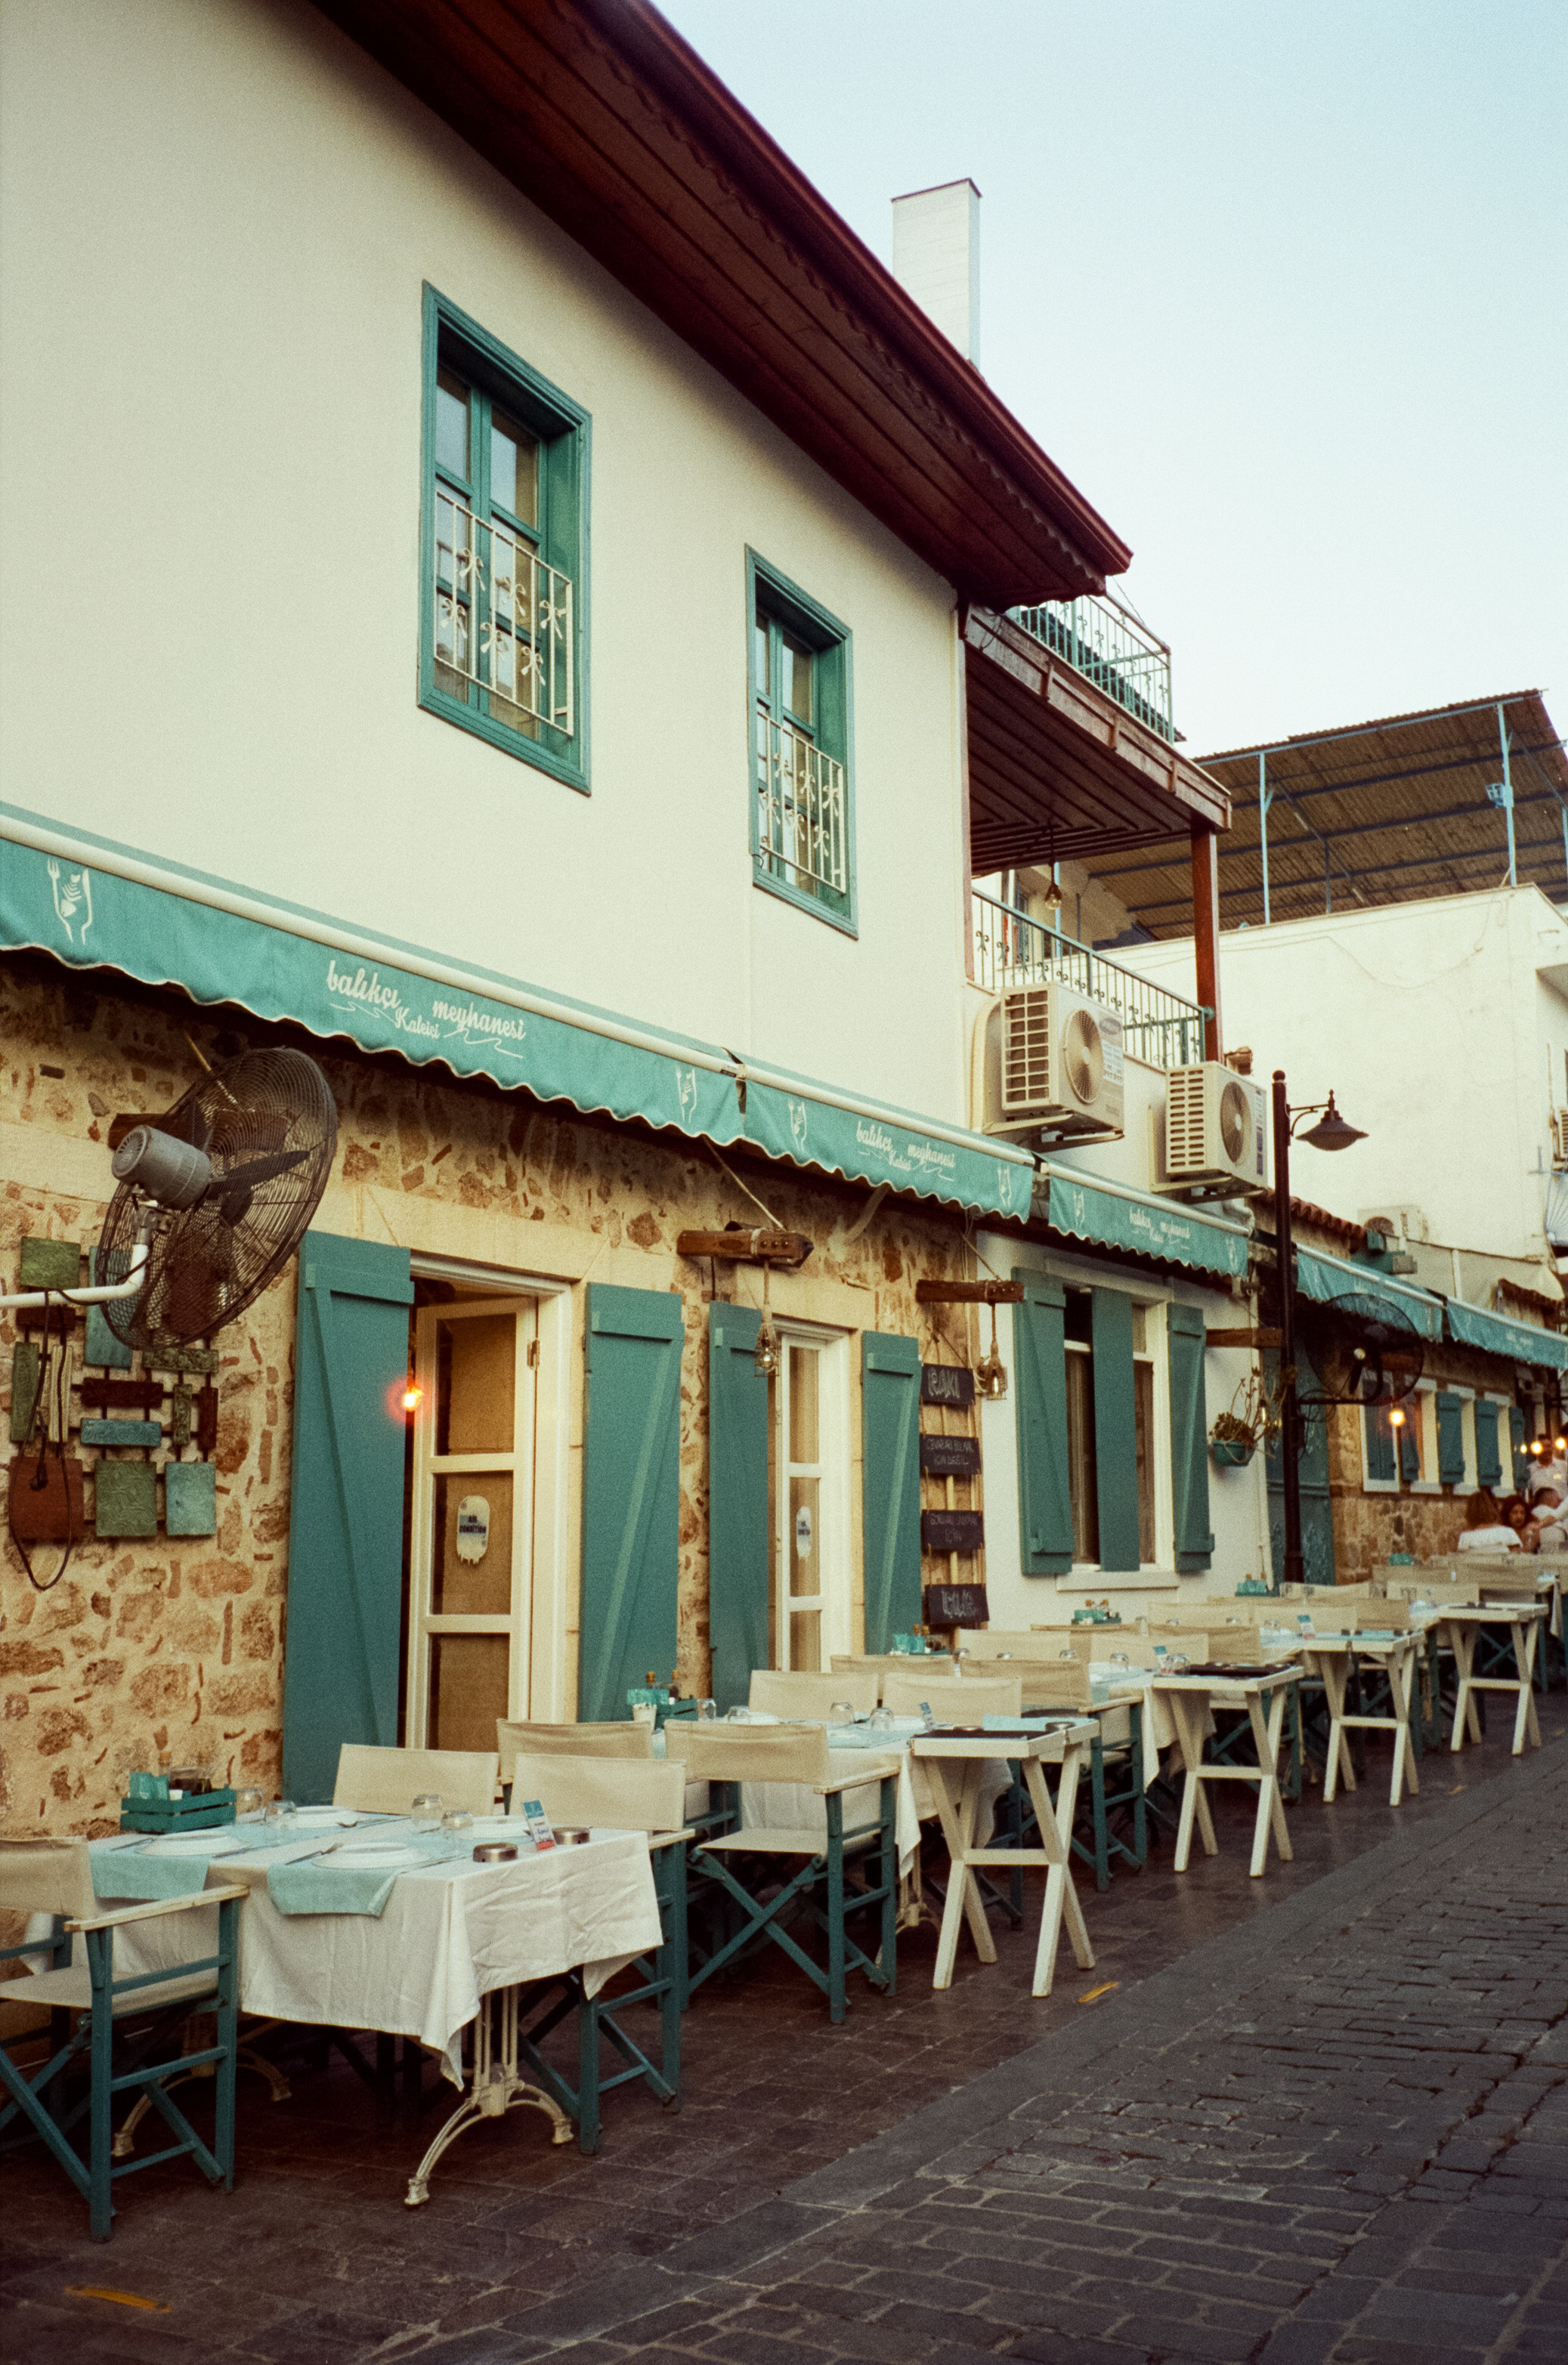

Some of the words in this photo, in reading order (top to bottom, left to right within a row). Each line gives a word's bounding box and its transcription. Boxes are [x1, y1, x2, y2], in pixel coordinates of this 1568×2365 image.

[326, 960, 401, 1009] balıkçı
[432, 1000, 527, 1040] meyhanesi
[394, 1006, 441, 1039] Kaleiçi
